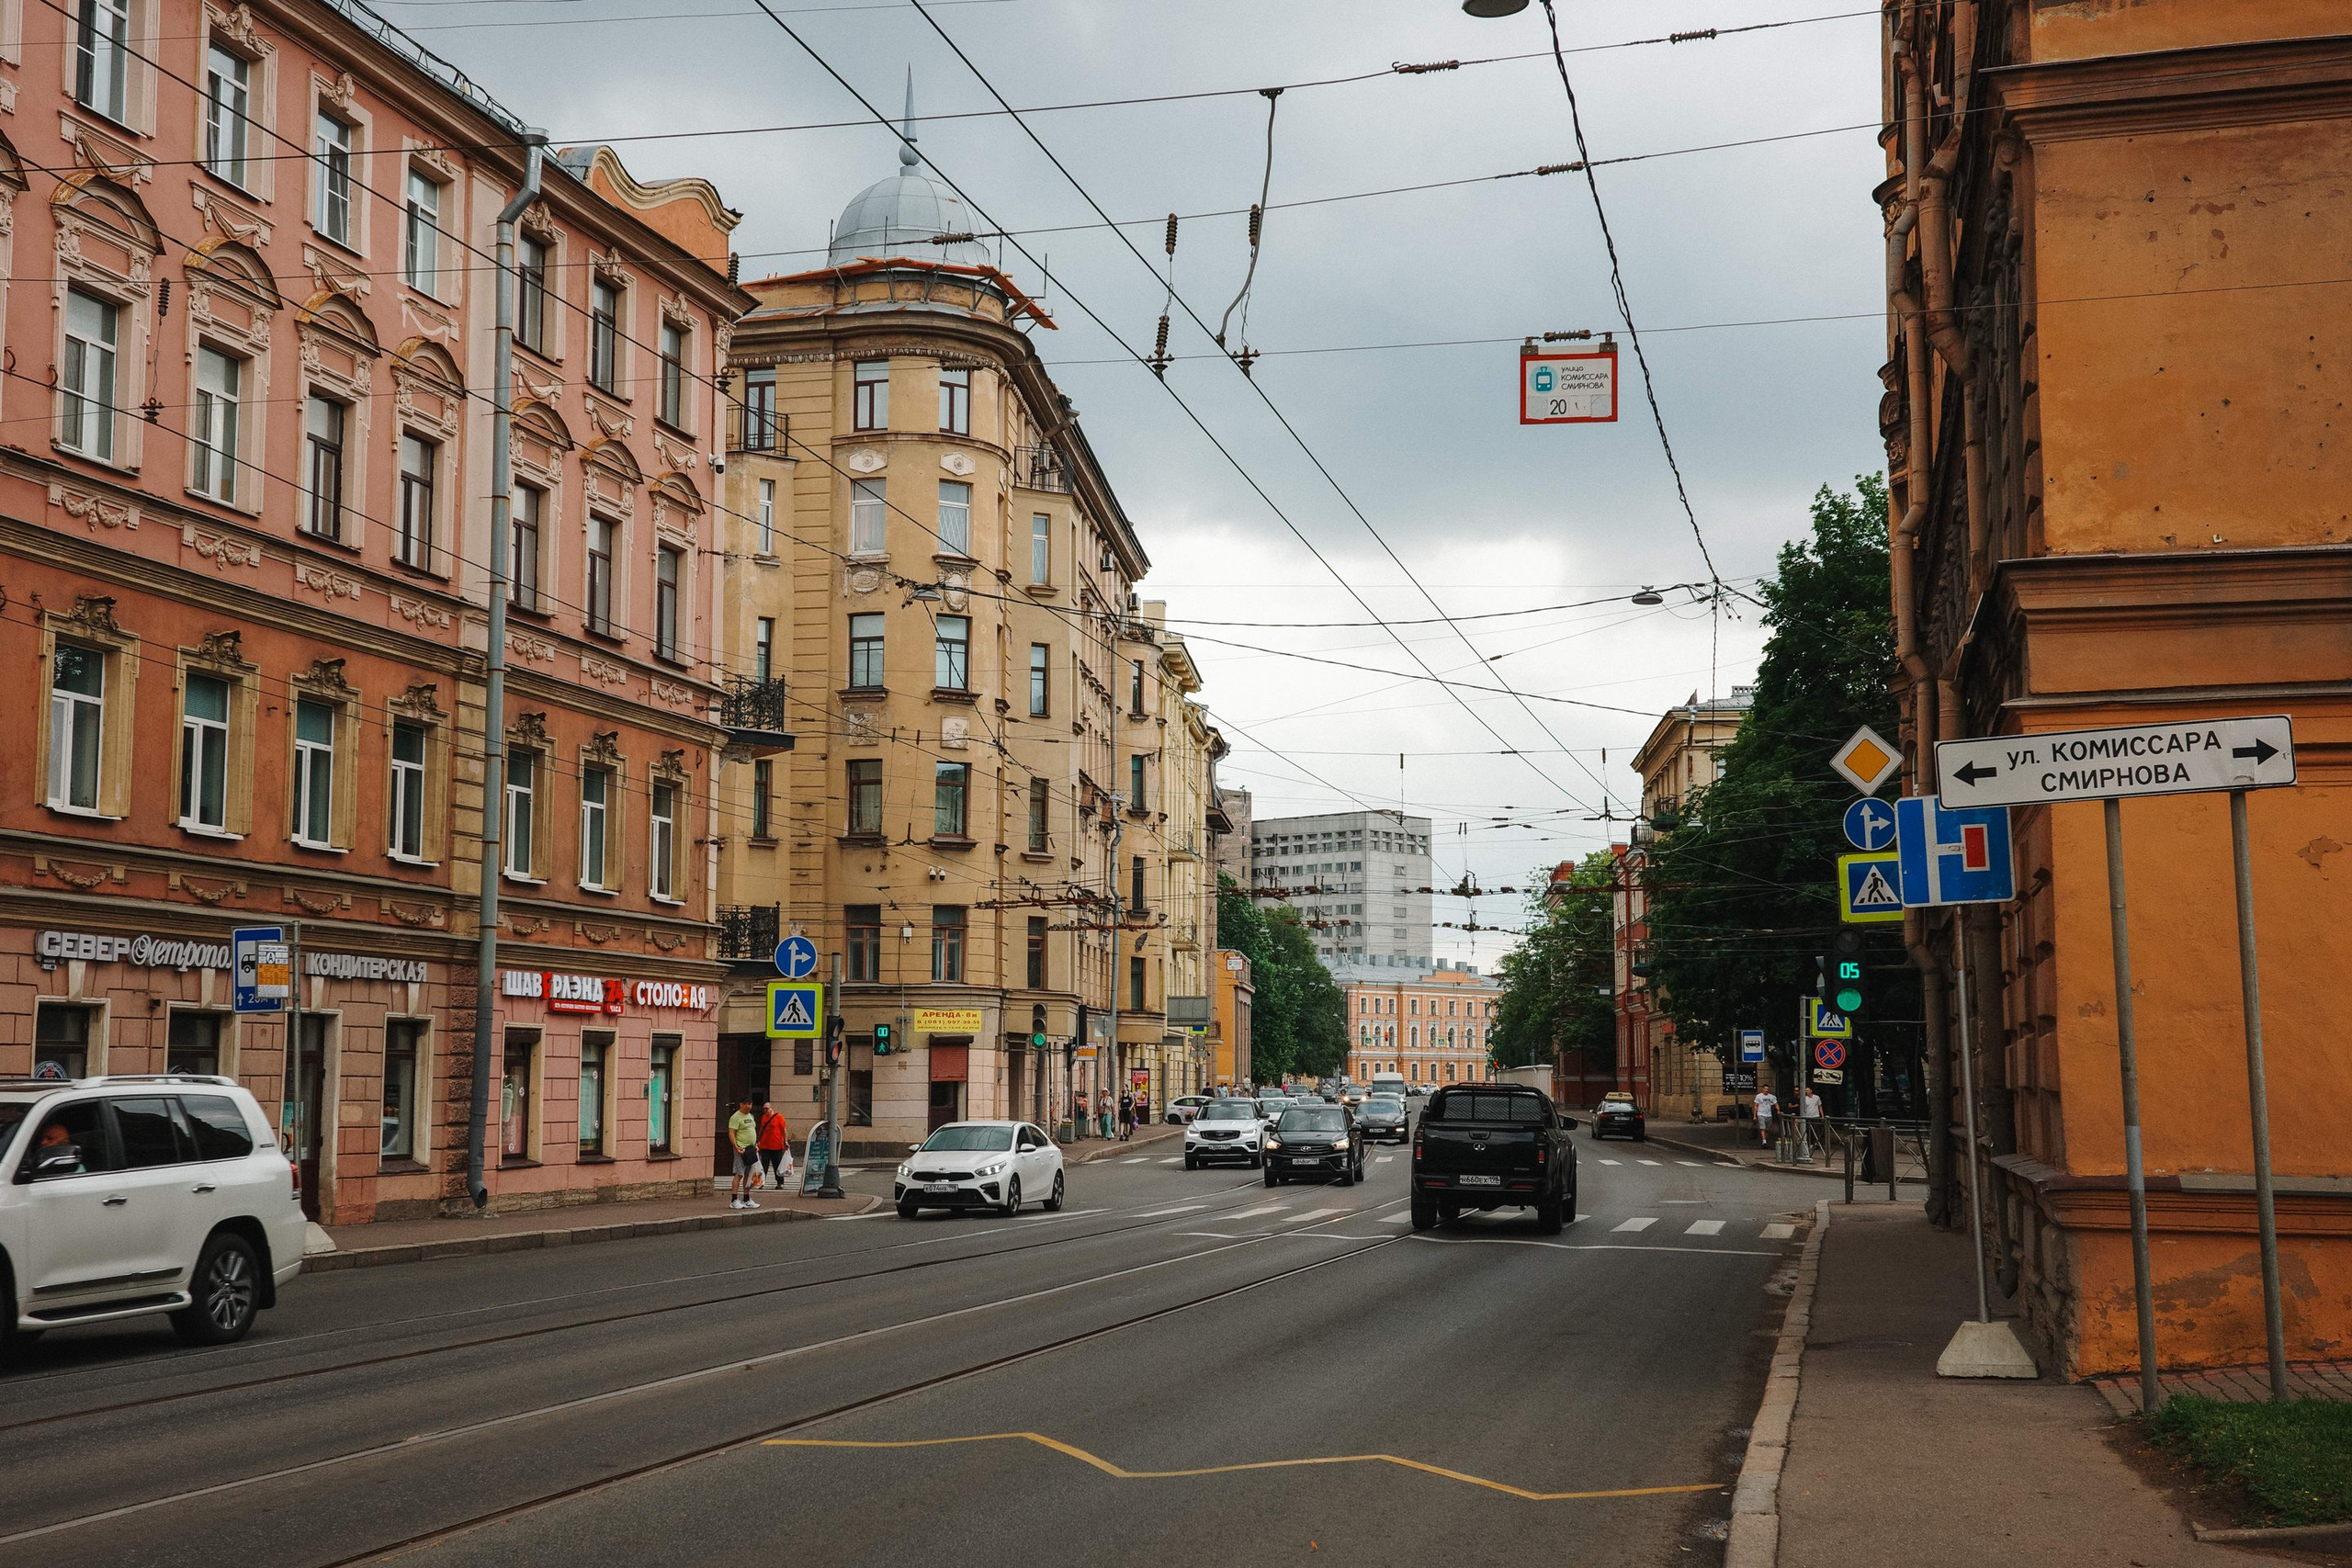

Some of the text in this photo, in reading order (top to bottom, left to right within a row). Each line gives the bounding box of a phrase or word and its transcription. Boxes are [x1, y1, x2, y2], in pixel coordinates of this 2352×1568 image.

[1561, 373, 1609, 381] КОМИССАРА
[1561, 381, 1605, 390] СМИРНОВА
[1549, 399, 1567, 415] 20
[2007, 730, 2222, 772] ул. КОМИССАРА
[2041, 762, 2191, 793] СМИРНОВА
[42, 931, 232, 973] СЕВЕР Метропо
[307, 953, 427, 982] КОНДИТЕРСКАЯ
[1840, 962, 1860, 979] 05
[505, 970, 604, 1003] ШАВЕРЛЭНД
[636, 981, 707, 1010] СТОЛОВАЯ
[1739, 1074, 1754, 1082] 10%
